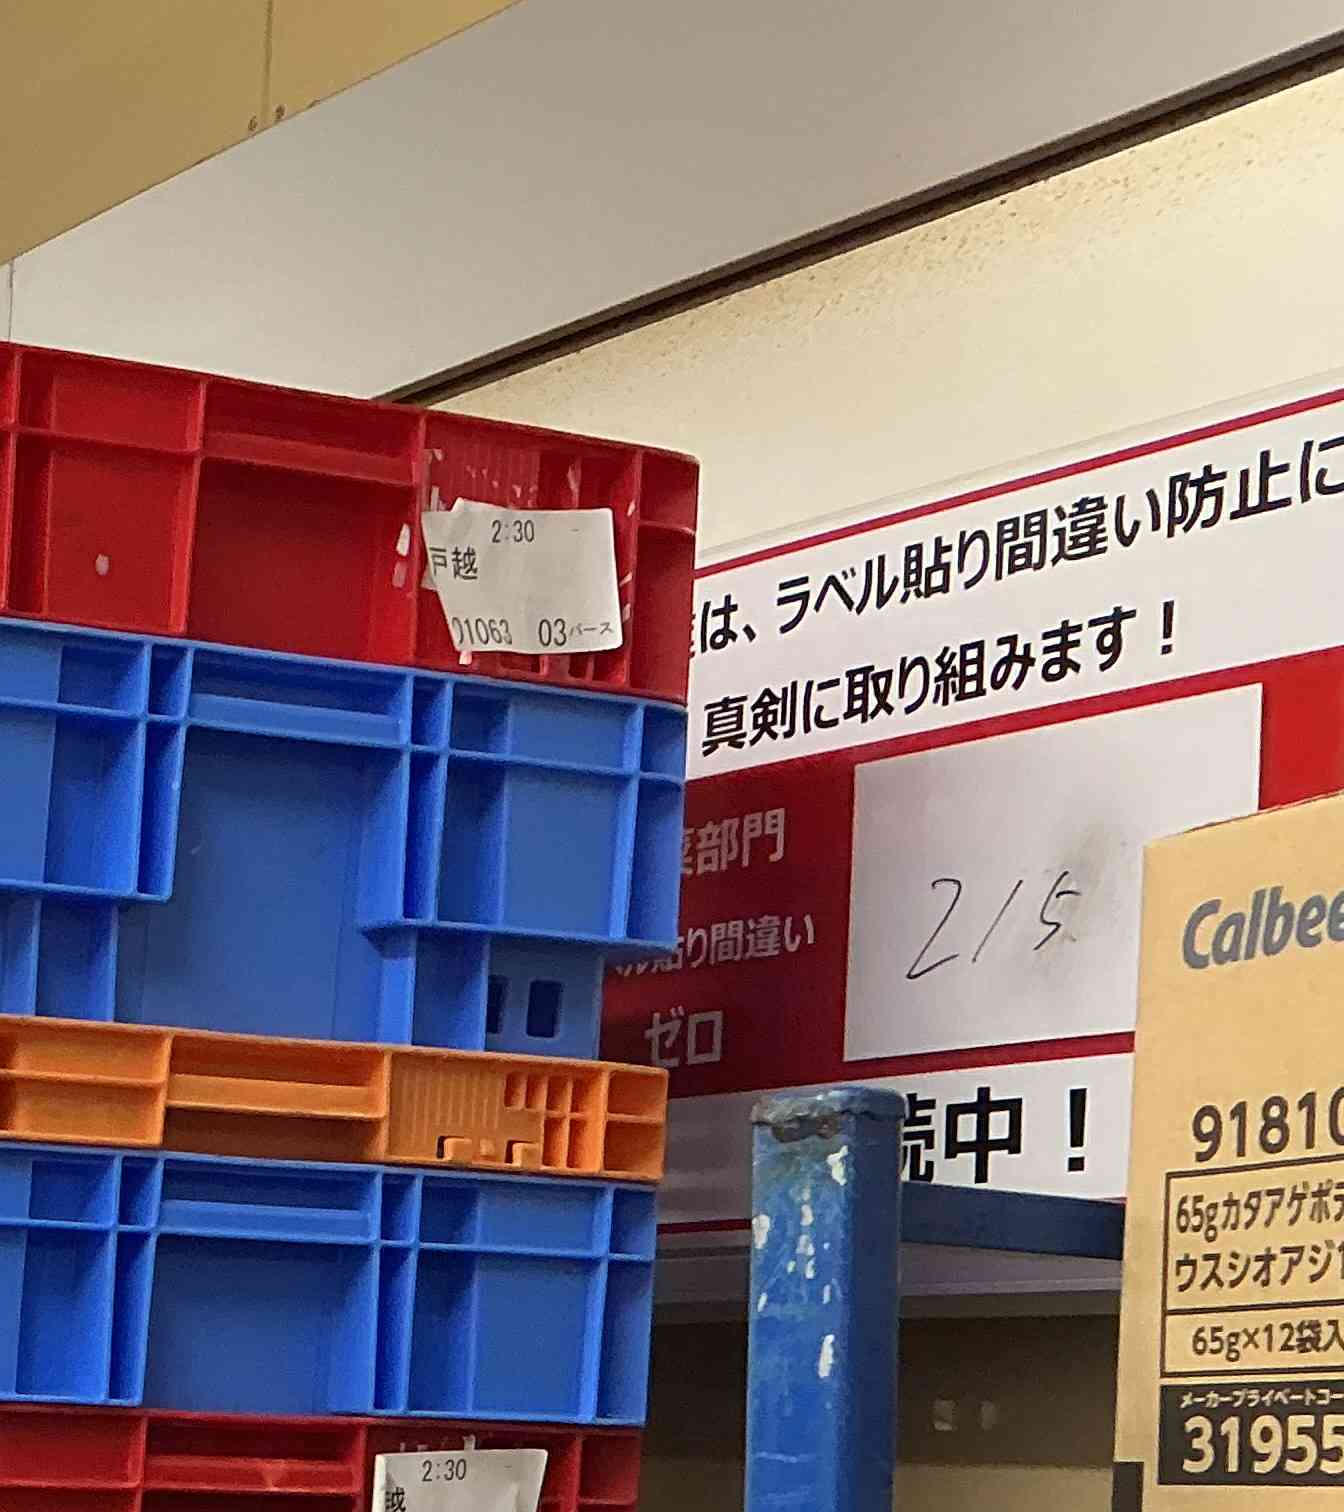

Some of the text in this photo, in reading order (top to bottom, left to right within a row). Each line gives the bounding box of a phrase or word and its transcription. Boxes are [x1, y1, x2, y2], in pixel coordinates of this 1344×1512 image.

[491, 519, 535, 544] 2:30
[689, 440, 1344, 660] は、ラベル貼り間違い防止に
[702, 600, 1175, 757] 真剣に取り組みます！
[616, 914, 815, 976] り間違い
[645, 1006, 723, 1068] ゼロ
[422, 1459, 467, 1482] 2:30
[1182, 1414, 1344, 1475] 31955
